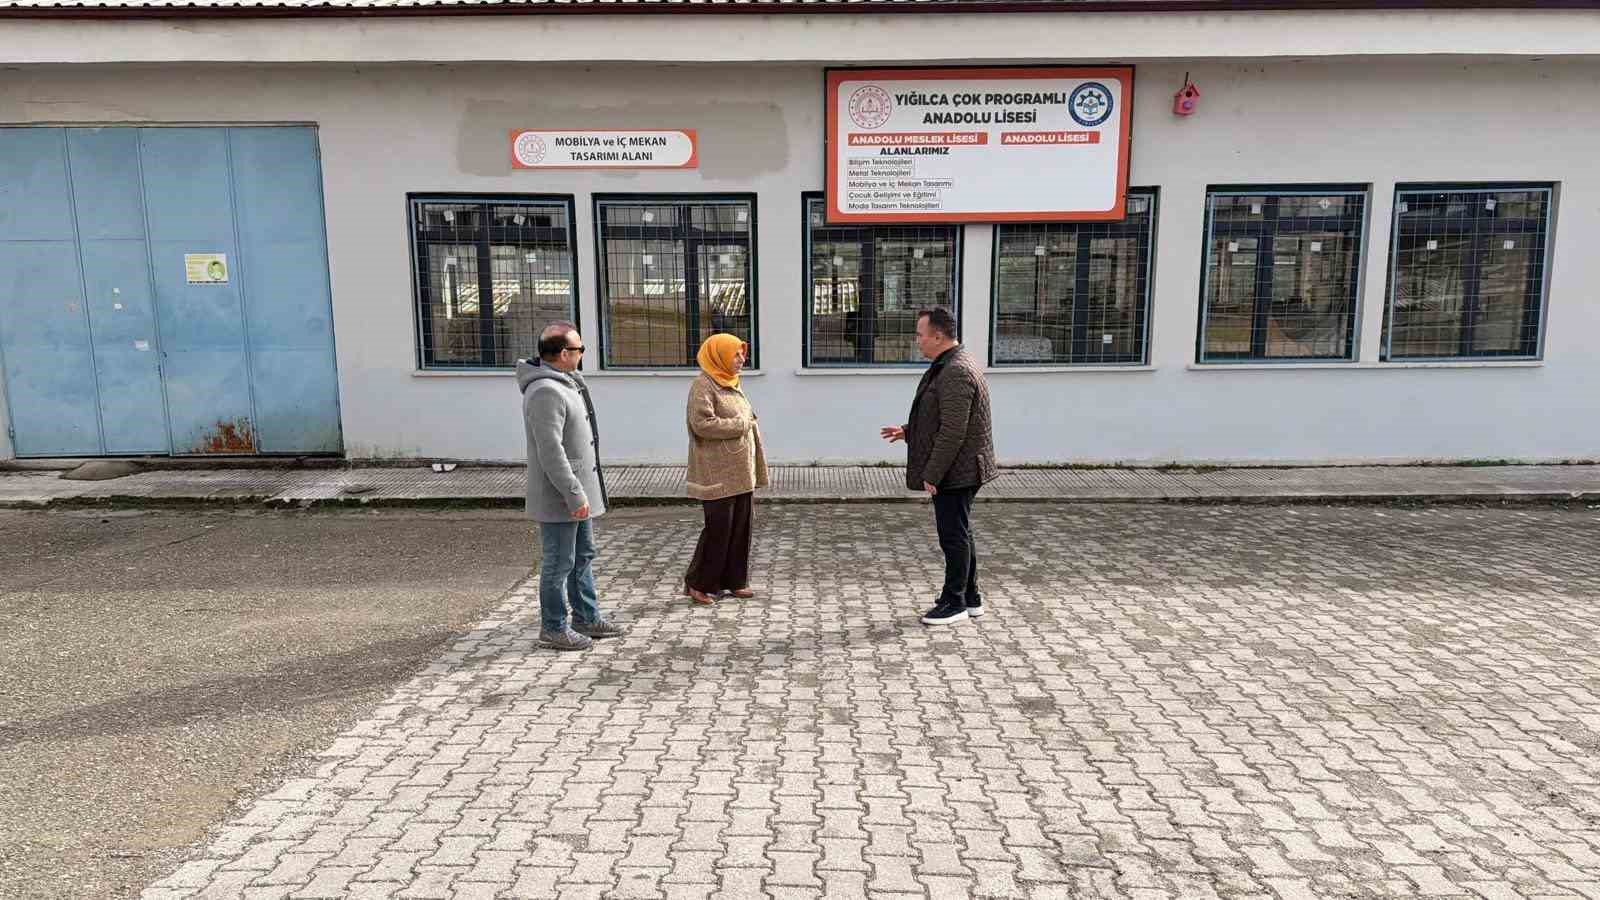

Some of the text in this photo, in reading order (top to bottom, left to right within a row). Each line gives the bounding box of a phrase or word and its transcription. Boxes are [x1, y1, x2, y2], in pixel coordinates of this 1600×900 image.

[895, 91, 1066, 107] YIĞILCA ÇOK PROGRAMLI
[922, 108, 1037, 124] ANADOLU LİSESİ
[555, 135, 600, 146] MOBİLYA
[617, 135, 626, 148] İÇ
[629, 136, 666, 146] MEKAN
[852, 133, 978, 145] ANADOLU MESLEK LİSESİ
[1004, 132, 1089, 143] ANADOLU LİSESİ
[570, 151, 653, 161] TASARIMI ALANI
[880, 147, 951, 156] ALANLARIMIZ
[871, 159, 912, 167] Teknolojileri
[848, 169, 911, 177] Metal Teknolojileri
[848, 181, 877, 190] Mobilya
[848, 191, 872, 200] Çocuk
[899, 202, 939, 210] Teknolojileri
